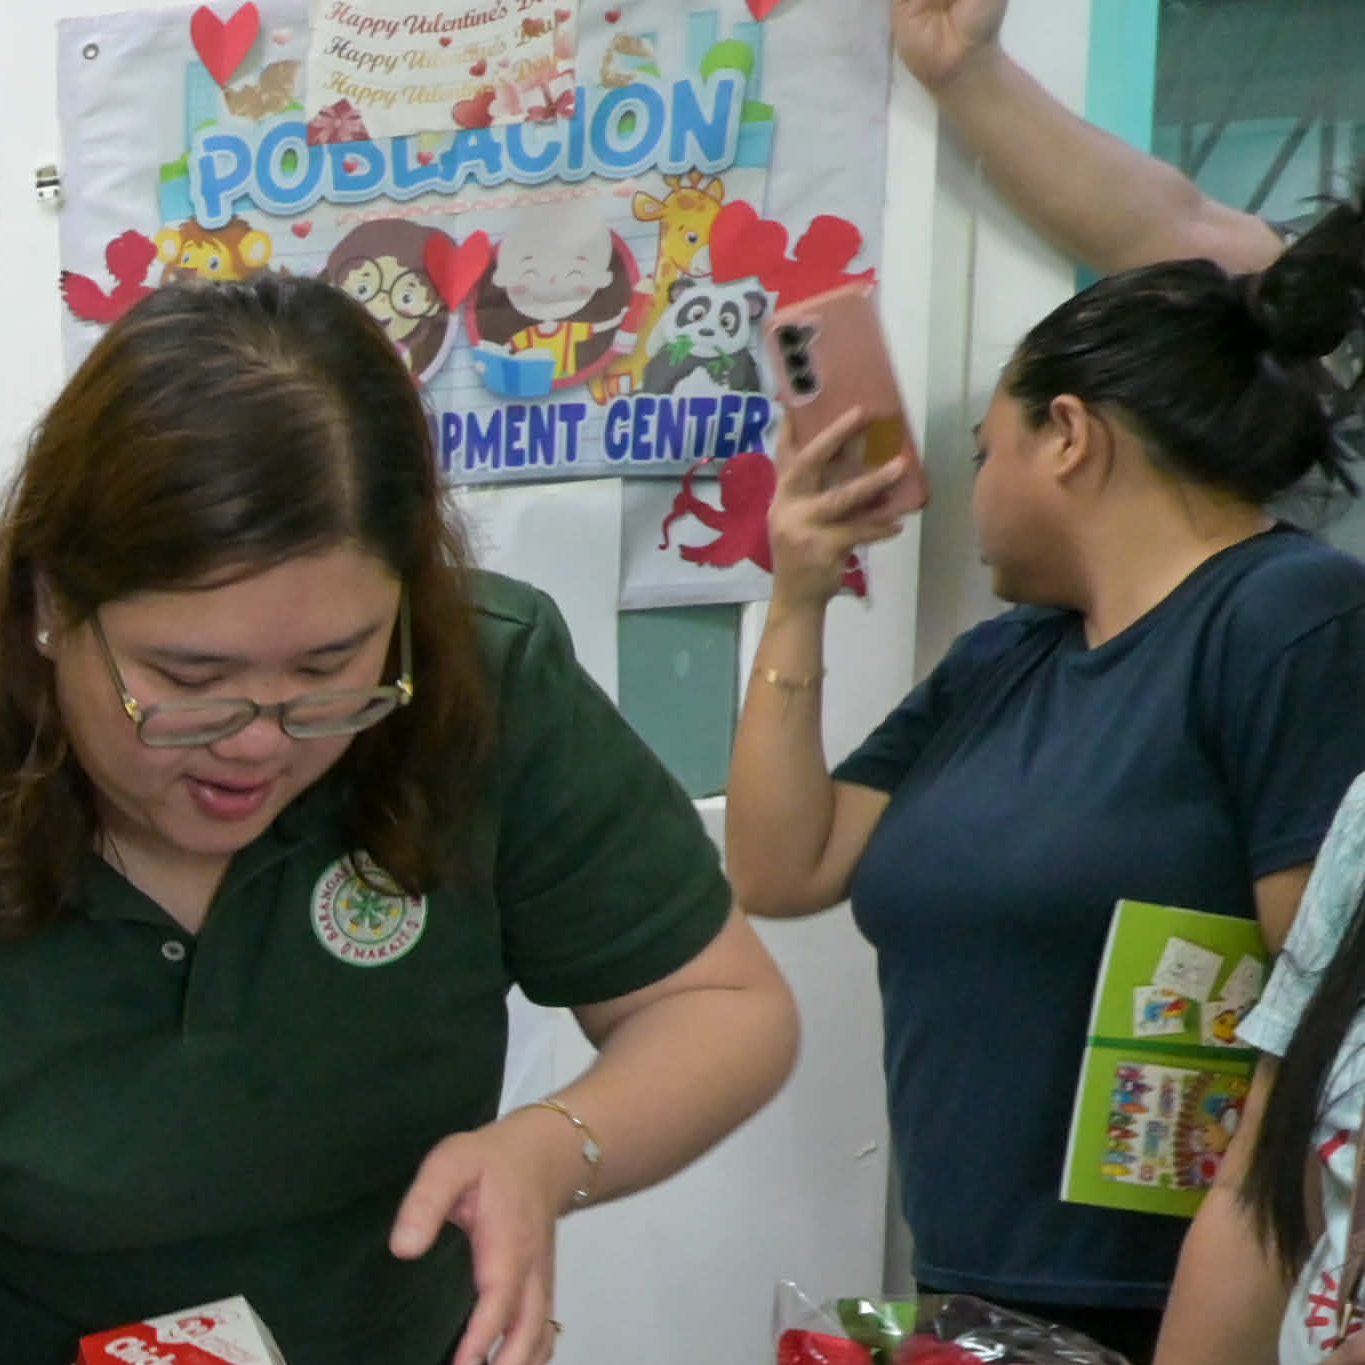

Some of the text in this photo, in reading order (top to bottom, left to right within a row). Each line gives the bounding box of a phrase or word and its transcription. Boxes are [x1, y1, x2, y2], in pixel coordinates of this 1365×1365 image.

[325, 1, 400, 39] Happy
[324, 36, 399, 72] Happy
[605, 395, 769, 461] CENTER
